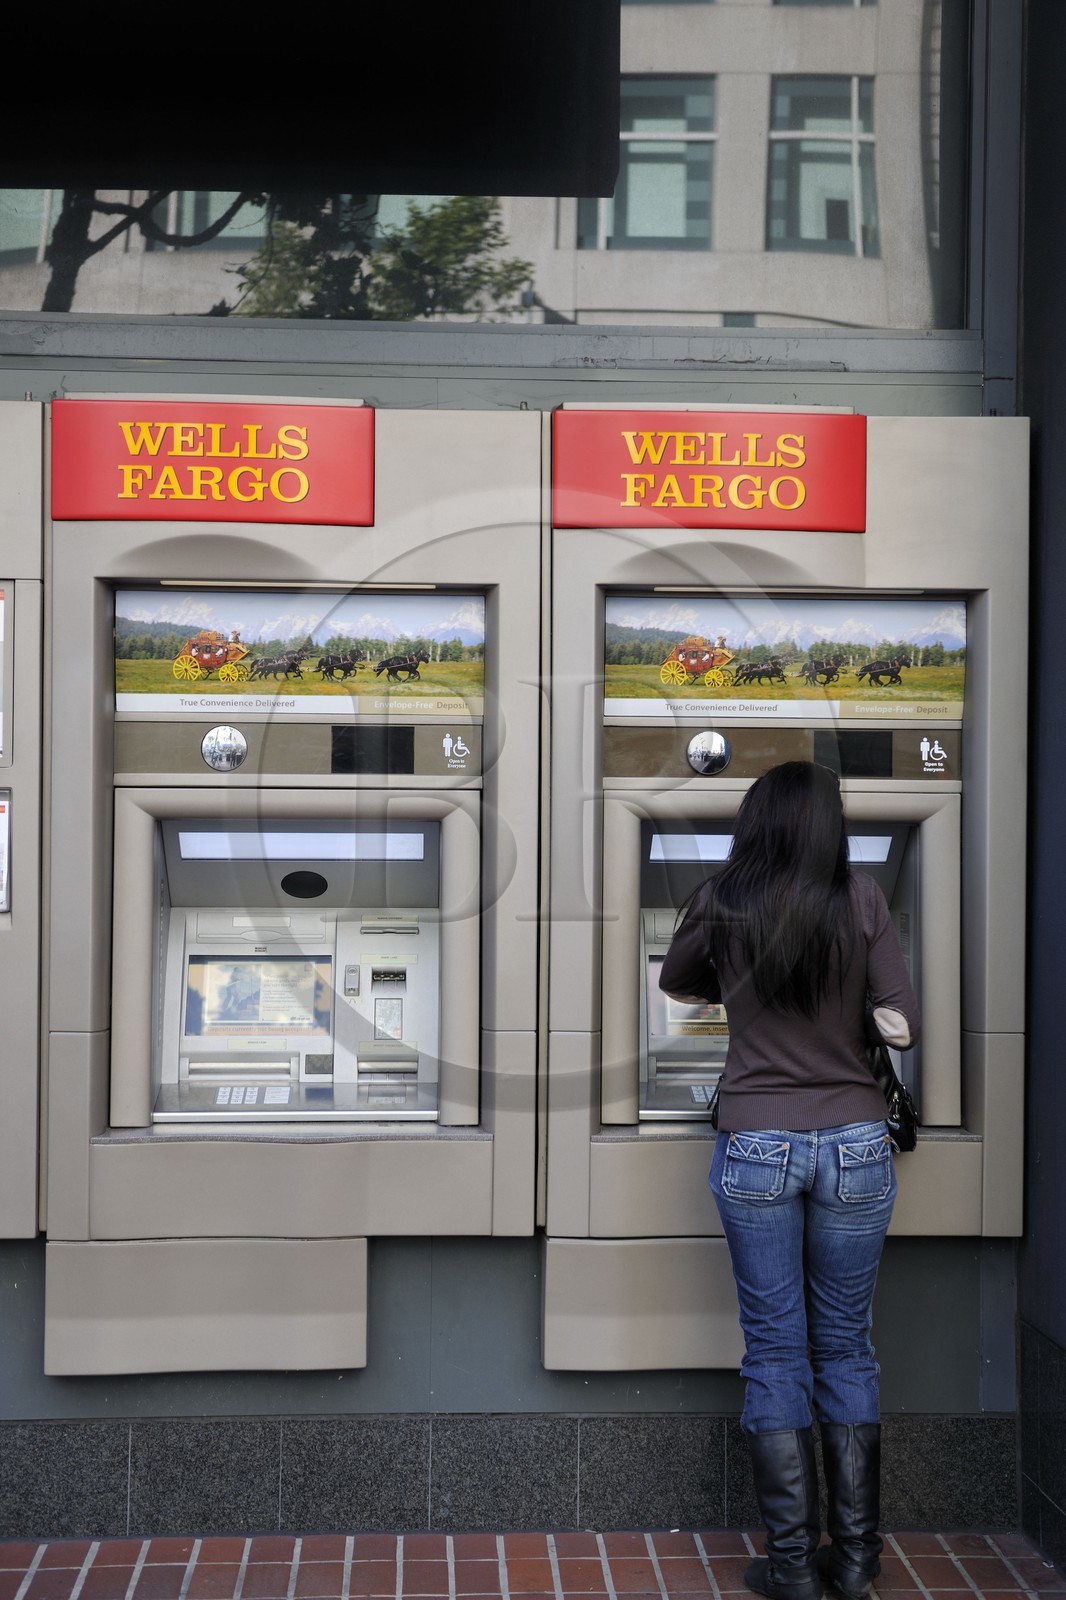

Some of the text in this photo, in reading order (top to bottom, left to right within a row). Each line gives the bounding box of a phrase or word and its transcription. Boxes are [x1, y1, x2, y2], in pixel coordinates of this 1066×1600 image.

[118, 421, 309, 460] WELLS
[620, 431, 807, 469] WELLS
[117, 464, 310, 503] FARGO
[620, 473, 807, 511] FARGO
[180, 698, 295, 708] True Convenience Delivered
[374, 700, 470, 711] Envelope-Free Deposit
[665, 703, 778, 712] True Convenience Delivered
[855, 705, 948, 714] Envelope-Free Deposit
